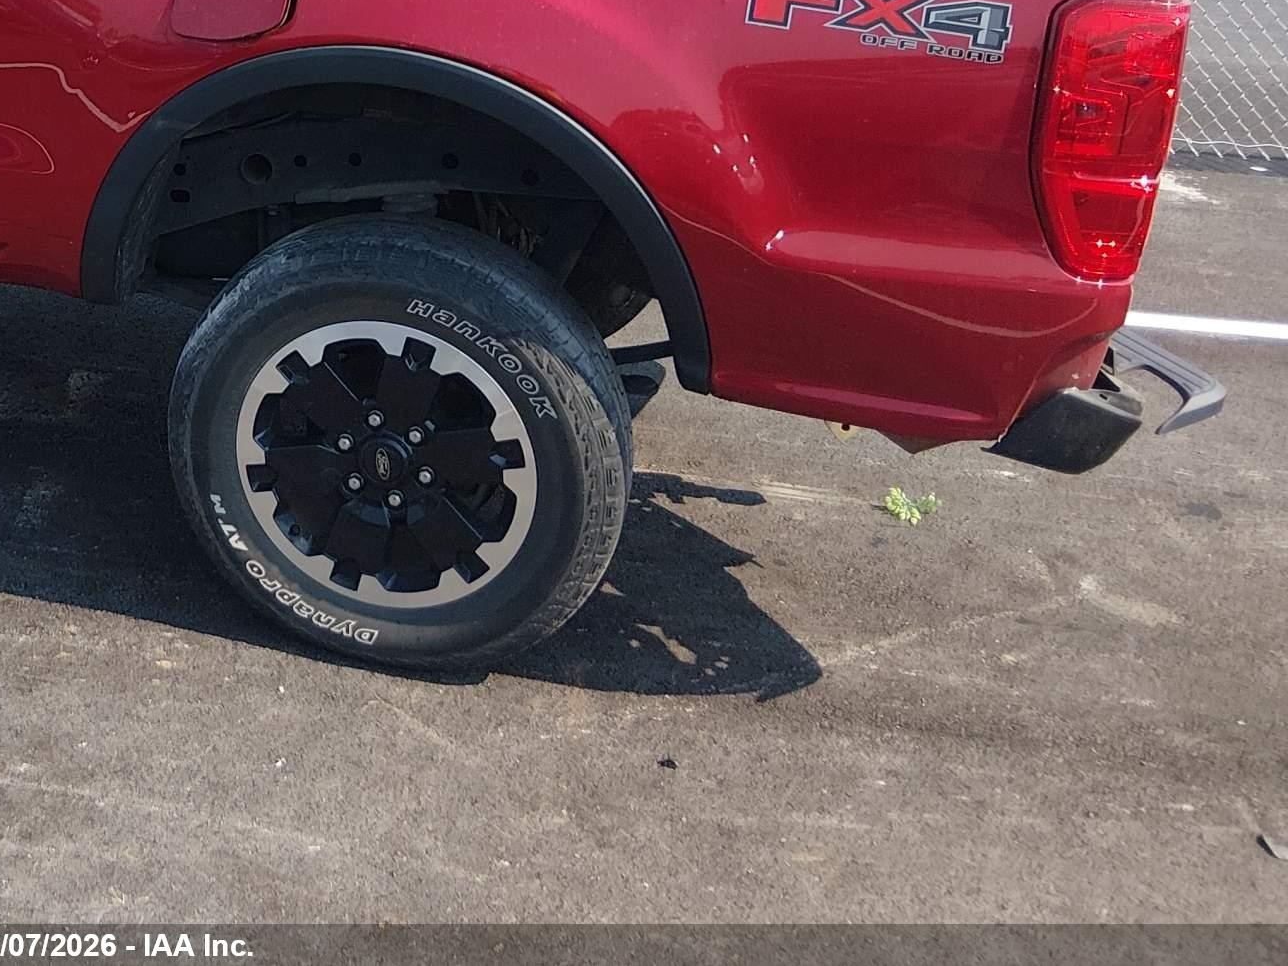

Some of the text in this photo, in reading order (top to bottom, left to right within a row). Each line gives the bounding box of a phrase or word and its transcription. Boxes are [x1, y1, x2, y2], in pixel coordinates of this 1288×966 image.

[860, 33, 1004, 64] OFF ROAD
[406, 299, 559, 420] Hankook
[245, 559, 379, 645] Dynapro
